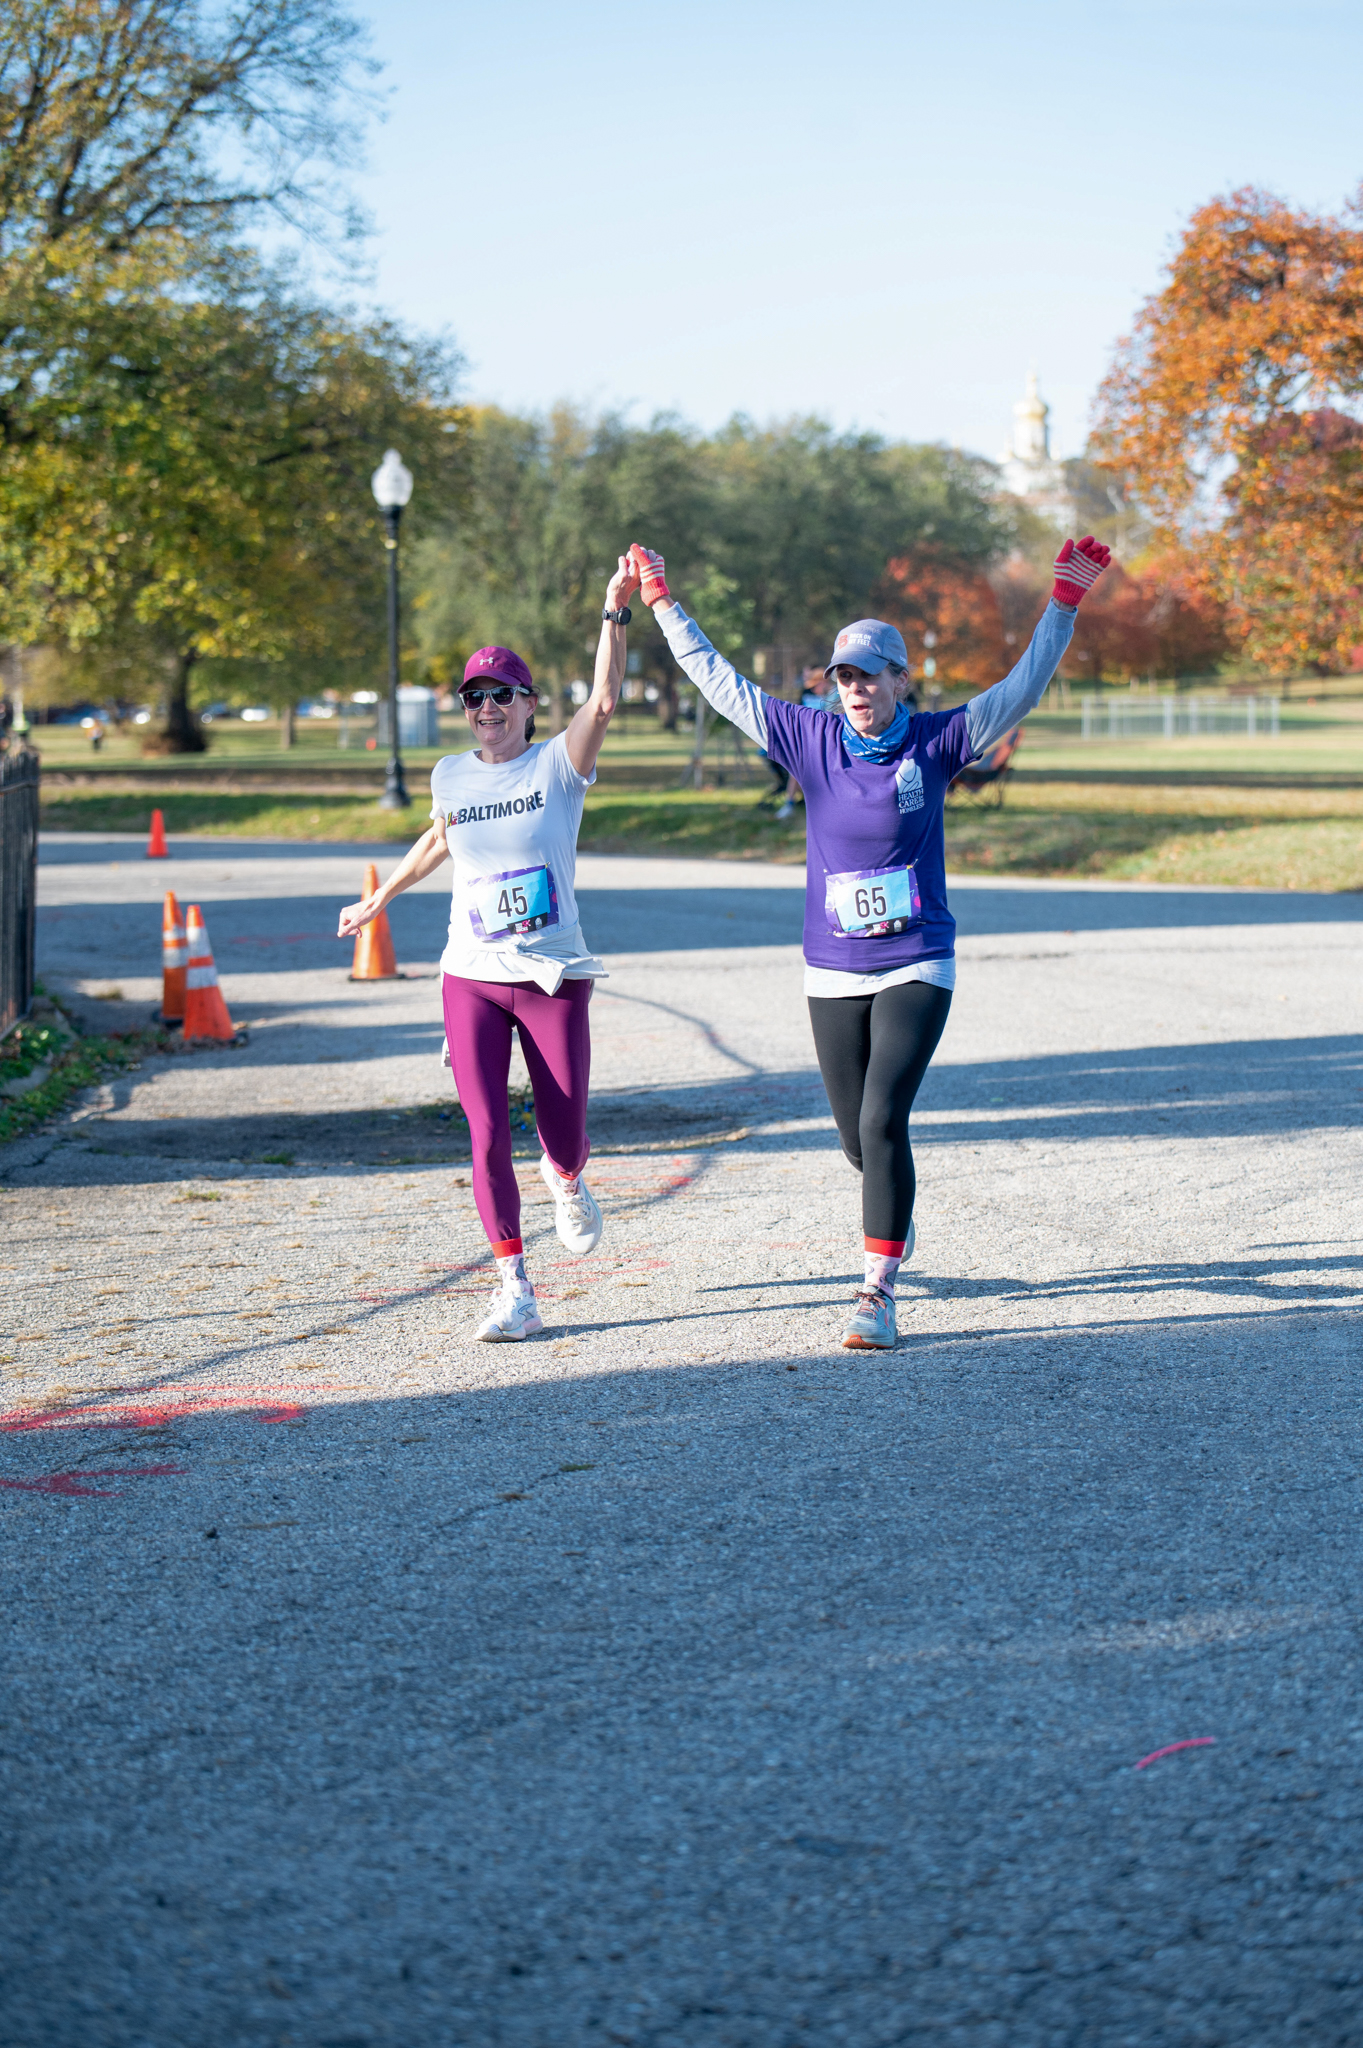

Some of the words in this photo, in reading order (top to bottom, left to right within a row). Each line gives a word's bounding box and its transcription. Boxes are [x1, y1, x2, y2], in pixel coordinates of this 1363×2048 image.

[898, 788, 924, 801] HEALTH
[898, 796, 919, 809] CARE
[458, 791, 545, 825] BALTIMORE
[899, 801, 925, 815] HOMELESS
[498, 886, 528, 917] 45
[855, 886, 887, 918] 65
